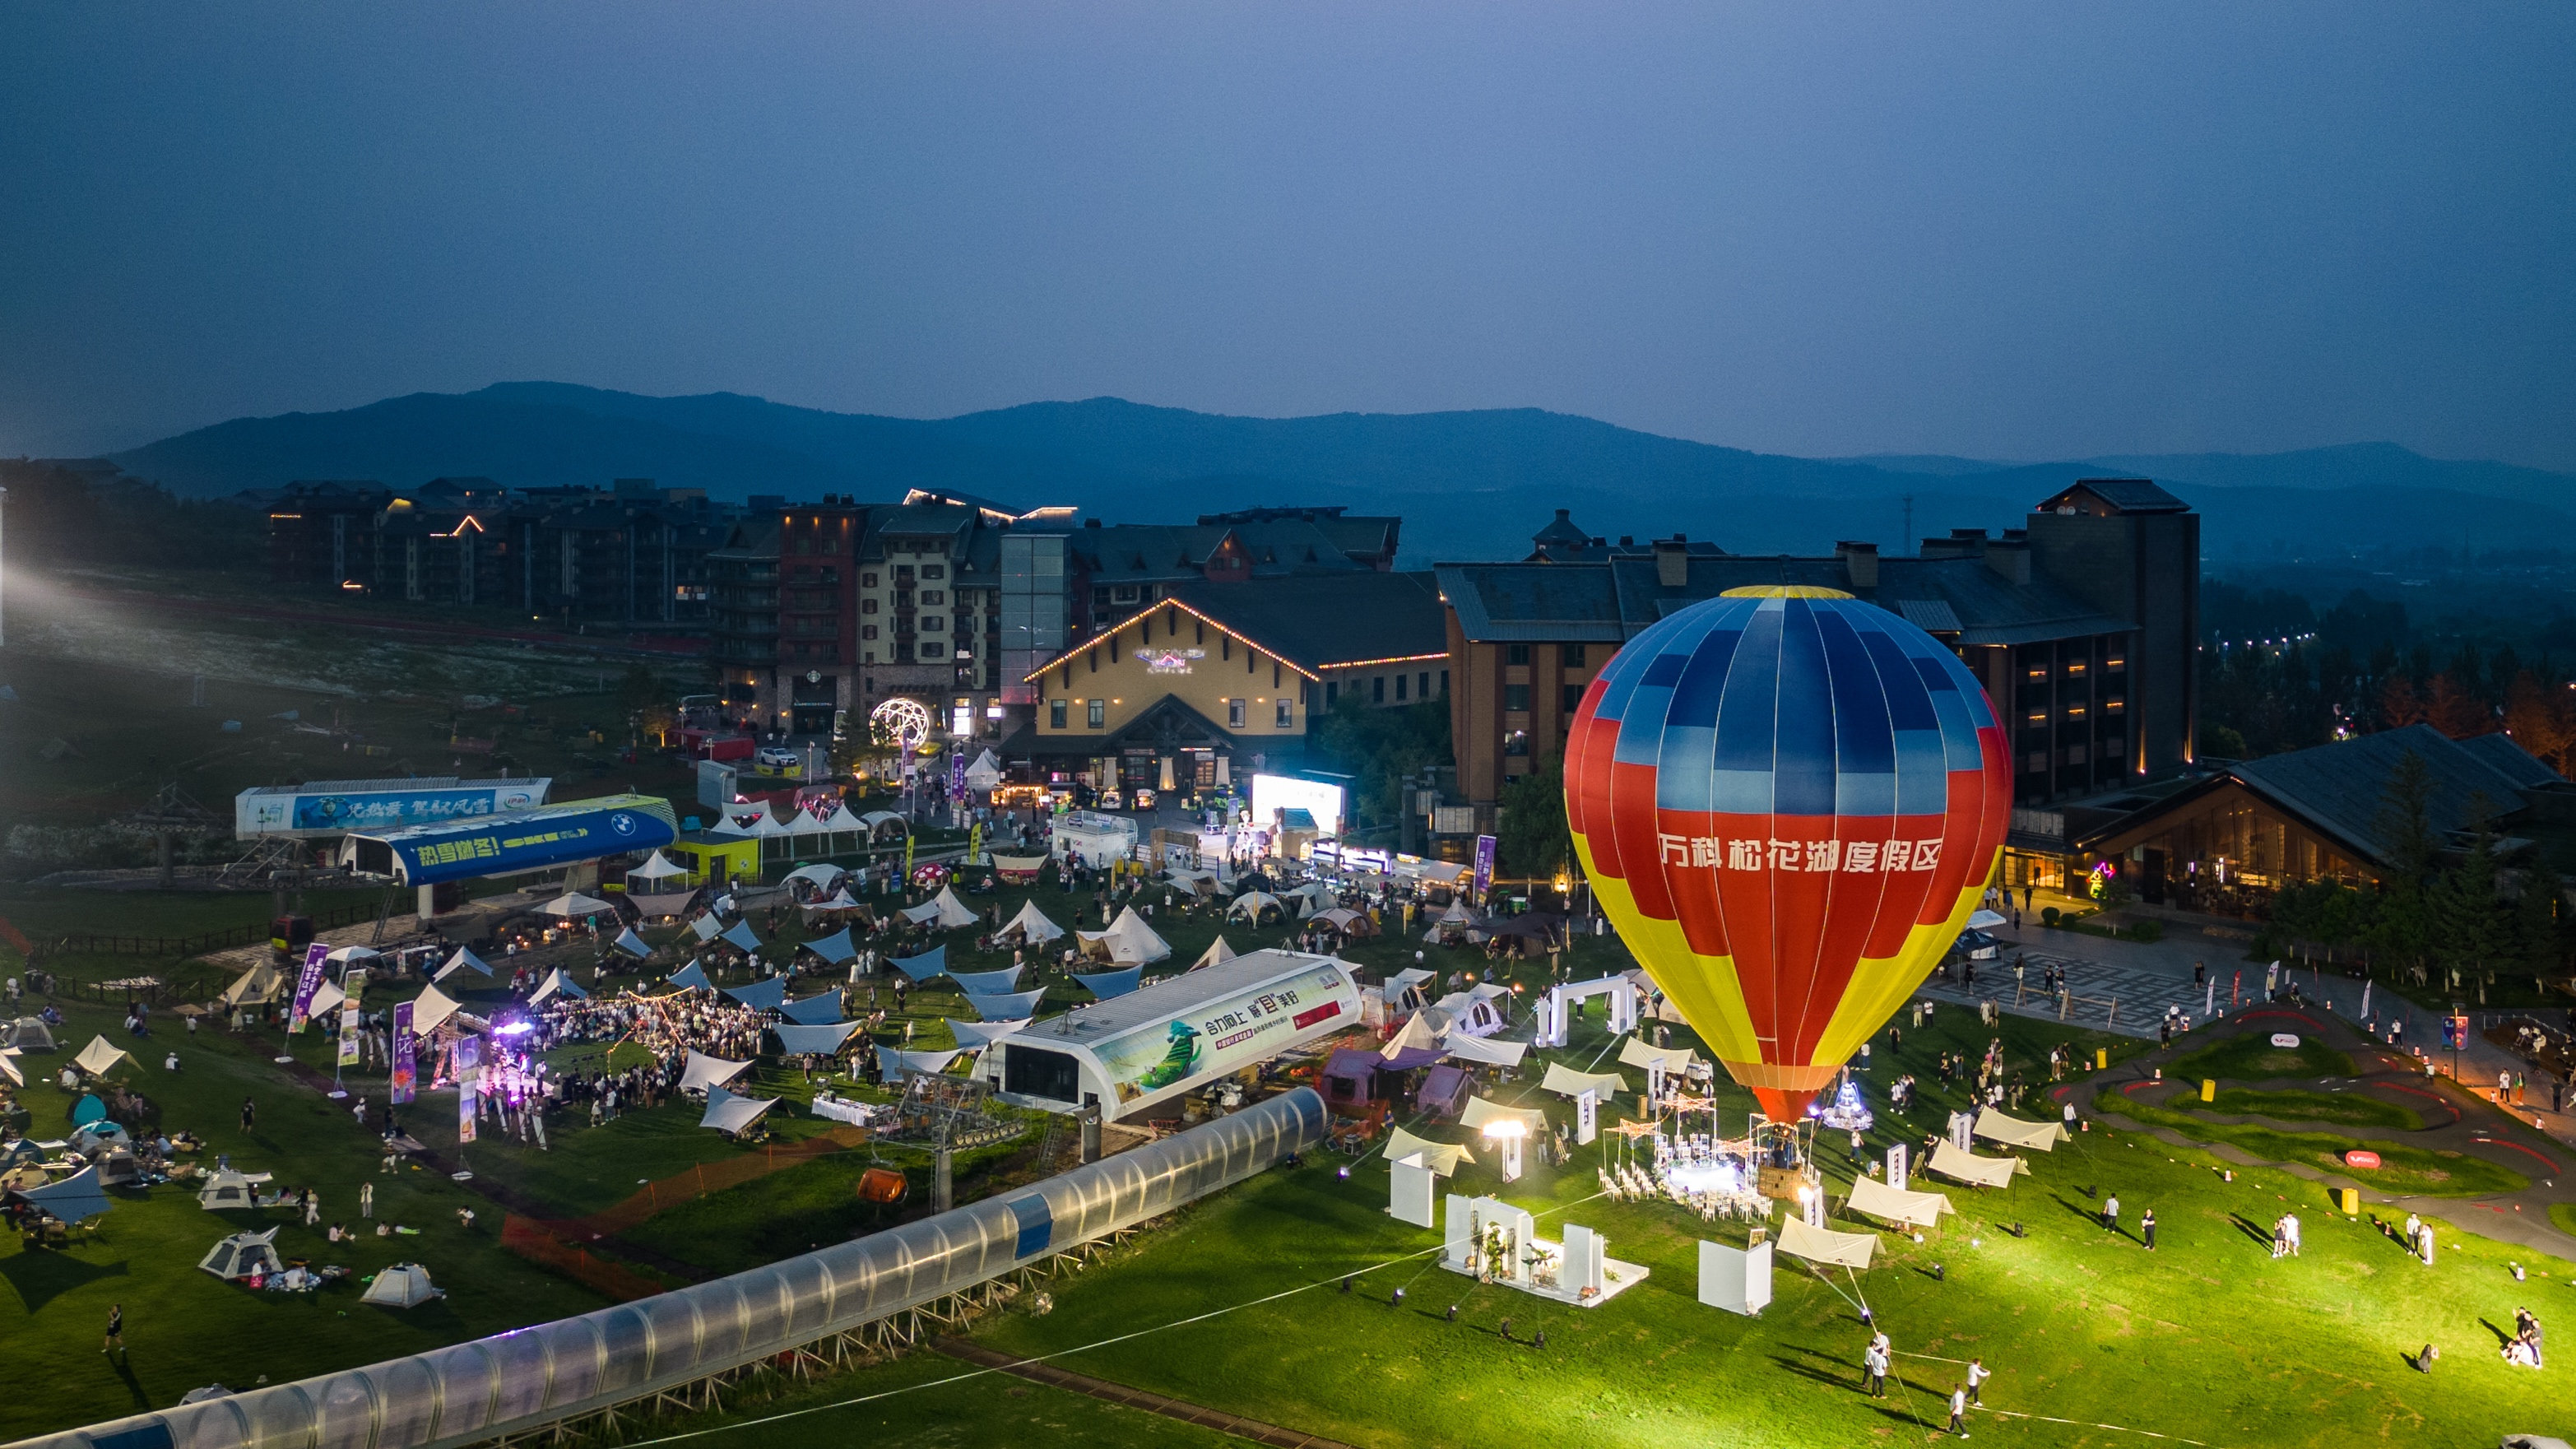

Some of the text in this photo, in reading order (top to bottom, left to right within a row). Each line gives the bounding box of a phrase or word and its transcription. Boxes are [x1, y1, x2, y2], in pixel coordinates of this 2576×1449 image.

[1659, 833, 1943, 873] 万科松花湖度假区
[1204, 1010, 1248, 1036] 合力向上
